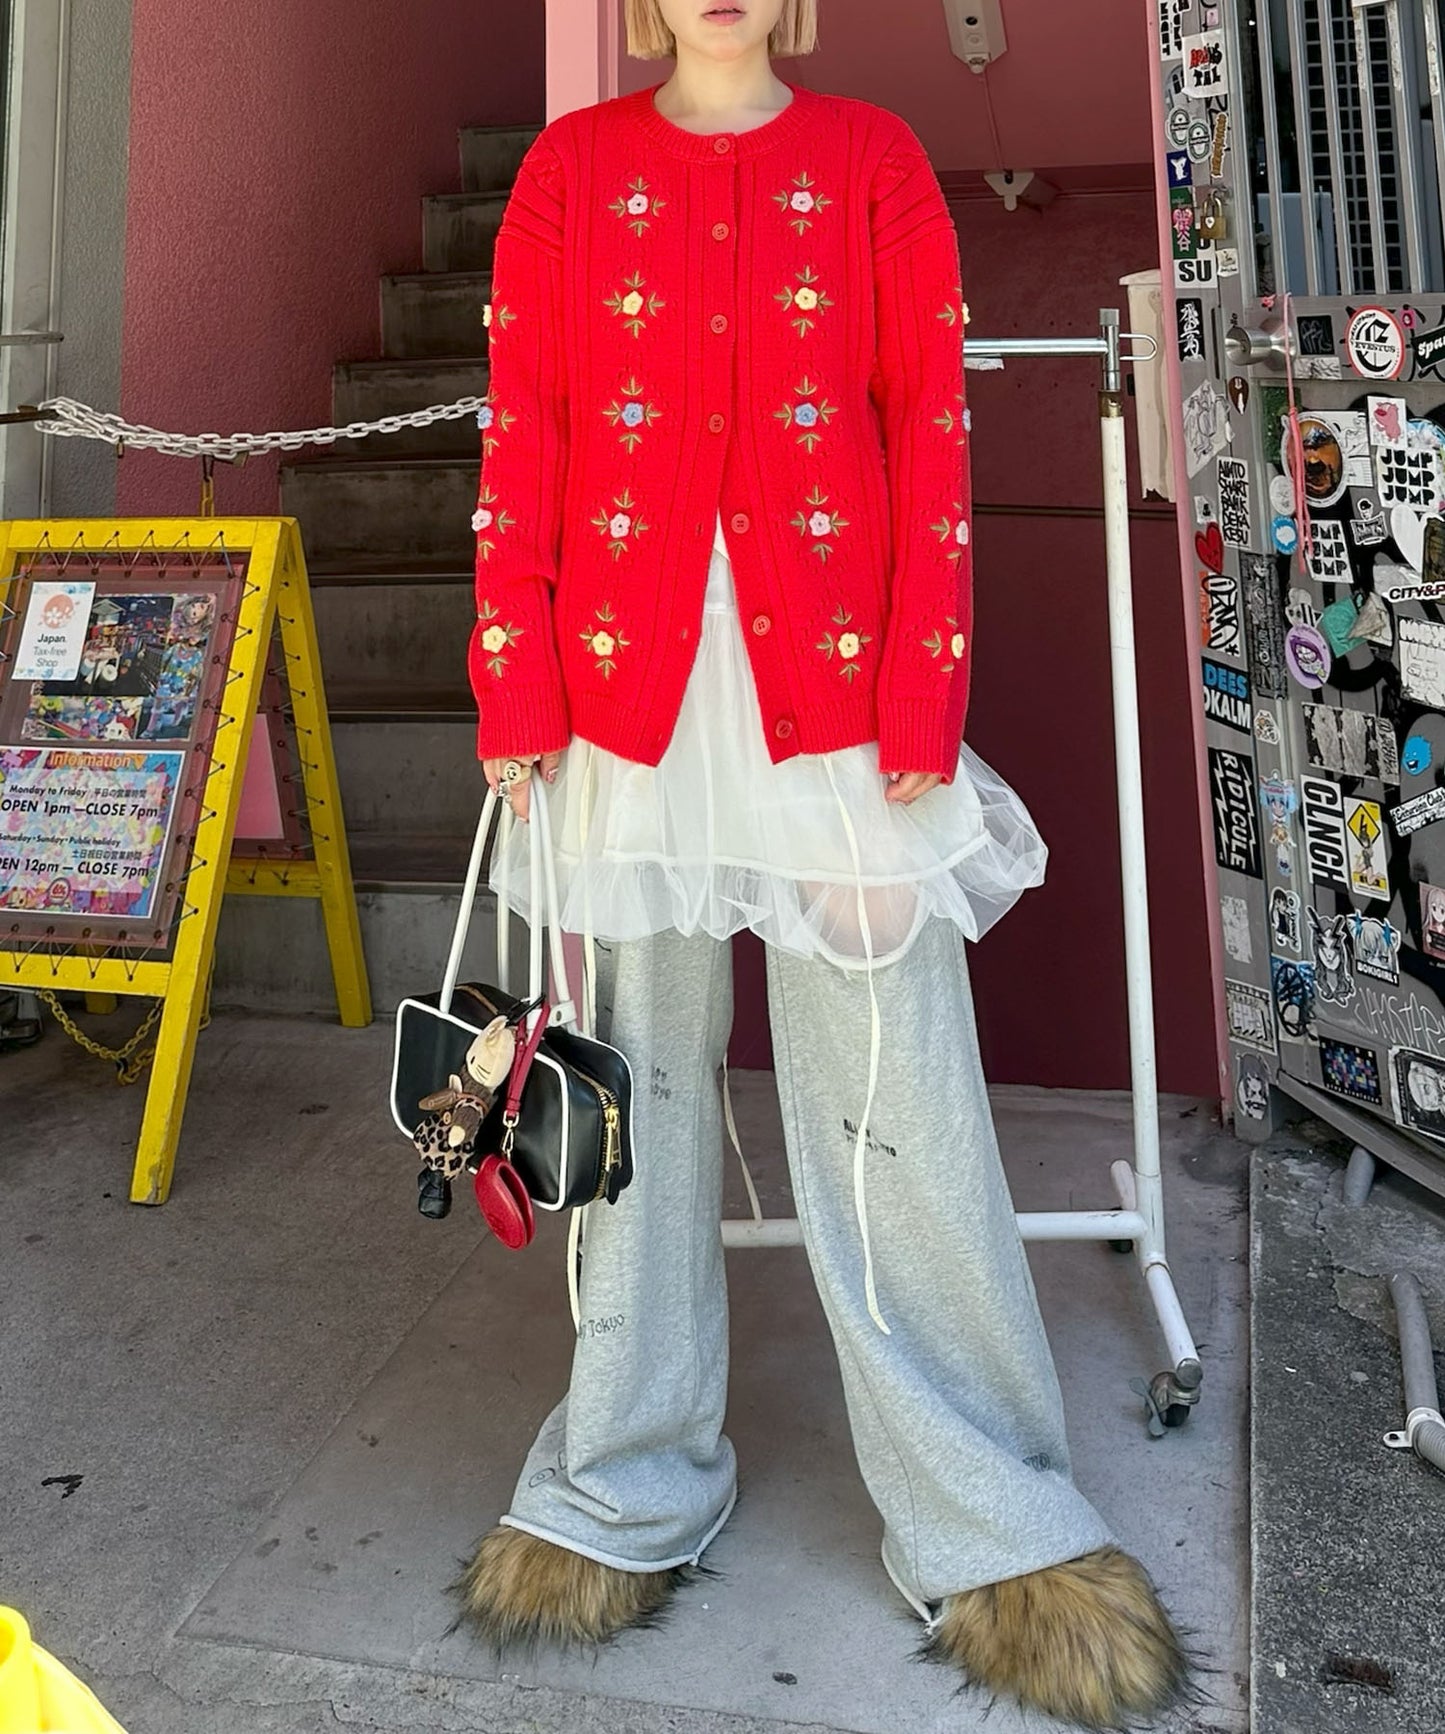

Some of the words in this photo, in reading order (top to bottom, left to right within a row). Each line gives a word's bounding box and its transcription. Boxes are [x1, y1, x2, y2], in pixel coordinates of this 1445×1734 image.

[1178, 260, 1212, 283] SU
[1418, 336, 1445, 359] Spa
[1381, 449, 1433, 468] JUMP
[1382, 467, 1435, 487] JUMP
[1383, 485, 1435, 506] JUMP
[37, 633, 66, 643] Japan
[33, 646, 67, 656] Tax-free
[35, 658, 58, 667] Shop
[1204, 663, 1247, 699] DEES
[9, 785, 45, 796] Monday
[48, 786, 57, 795] to
[59, 787, 87, 798] Friday
[1, 800, 38, 812] OPEN
[44, 802, 71, 816] 1pm
[86, 802, 126, 816] CLOSE
[129, 804, 158, 820] 7pm
[1221, 752, 1247, 870] RIDICULE
[25, 858, 59, 875] 12pm
[77, 861, 118, 875] CLOSE
[121, 866, 149, 880] 7pm
